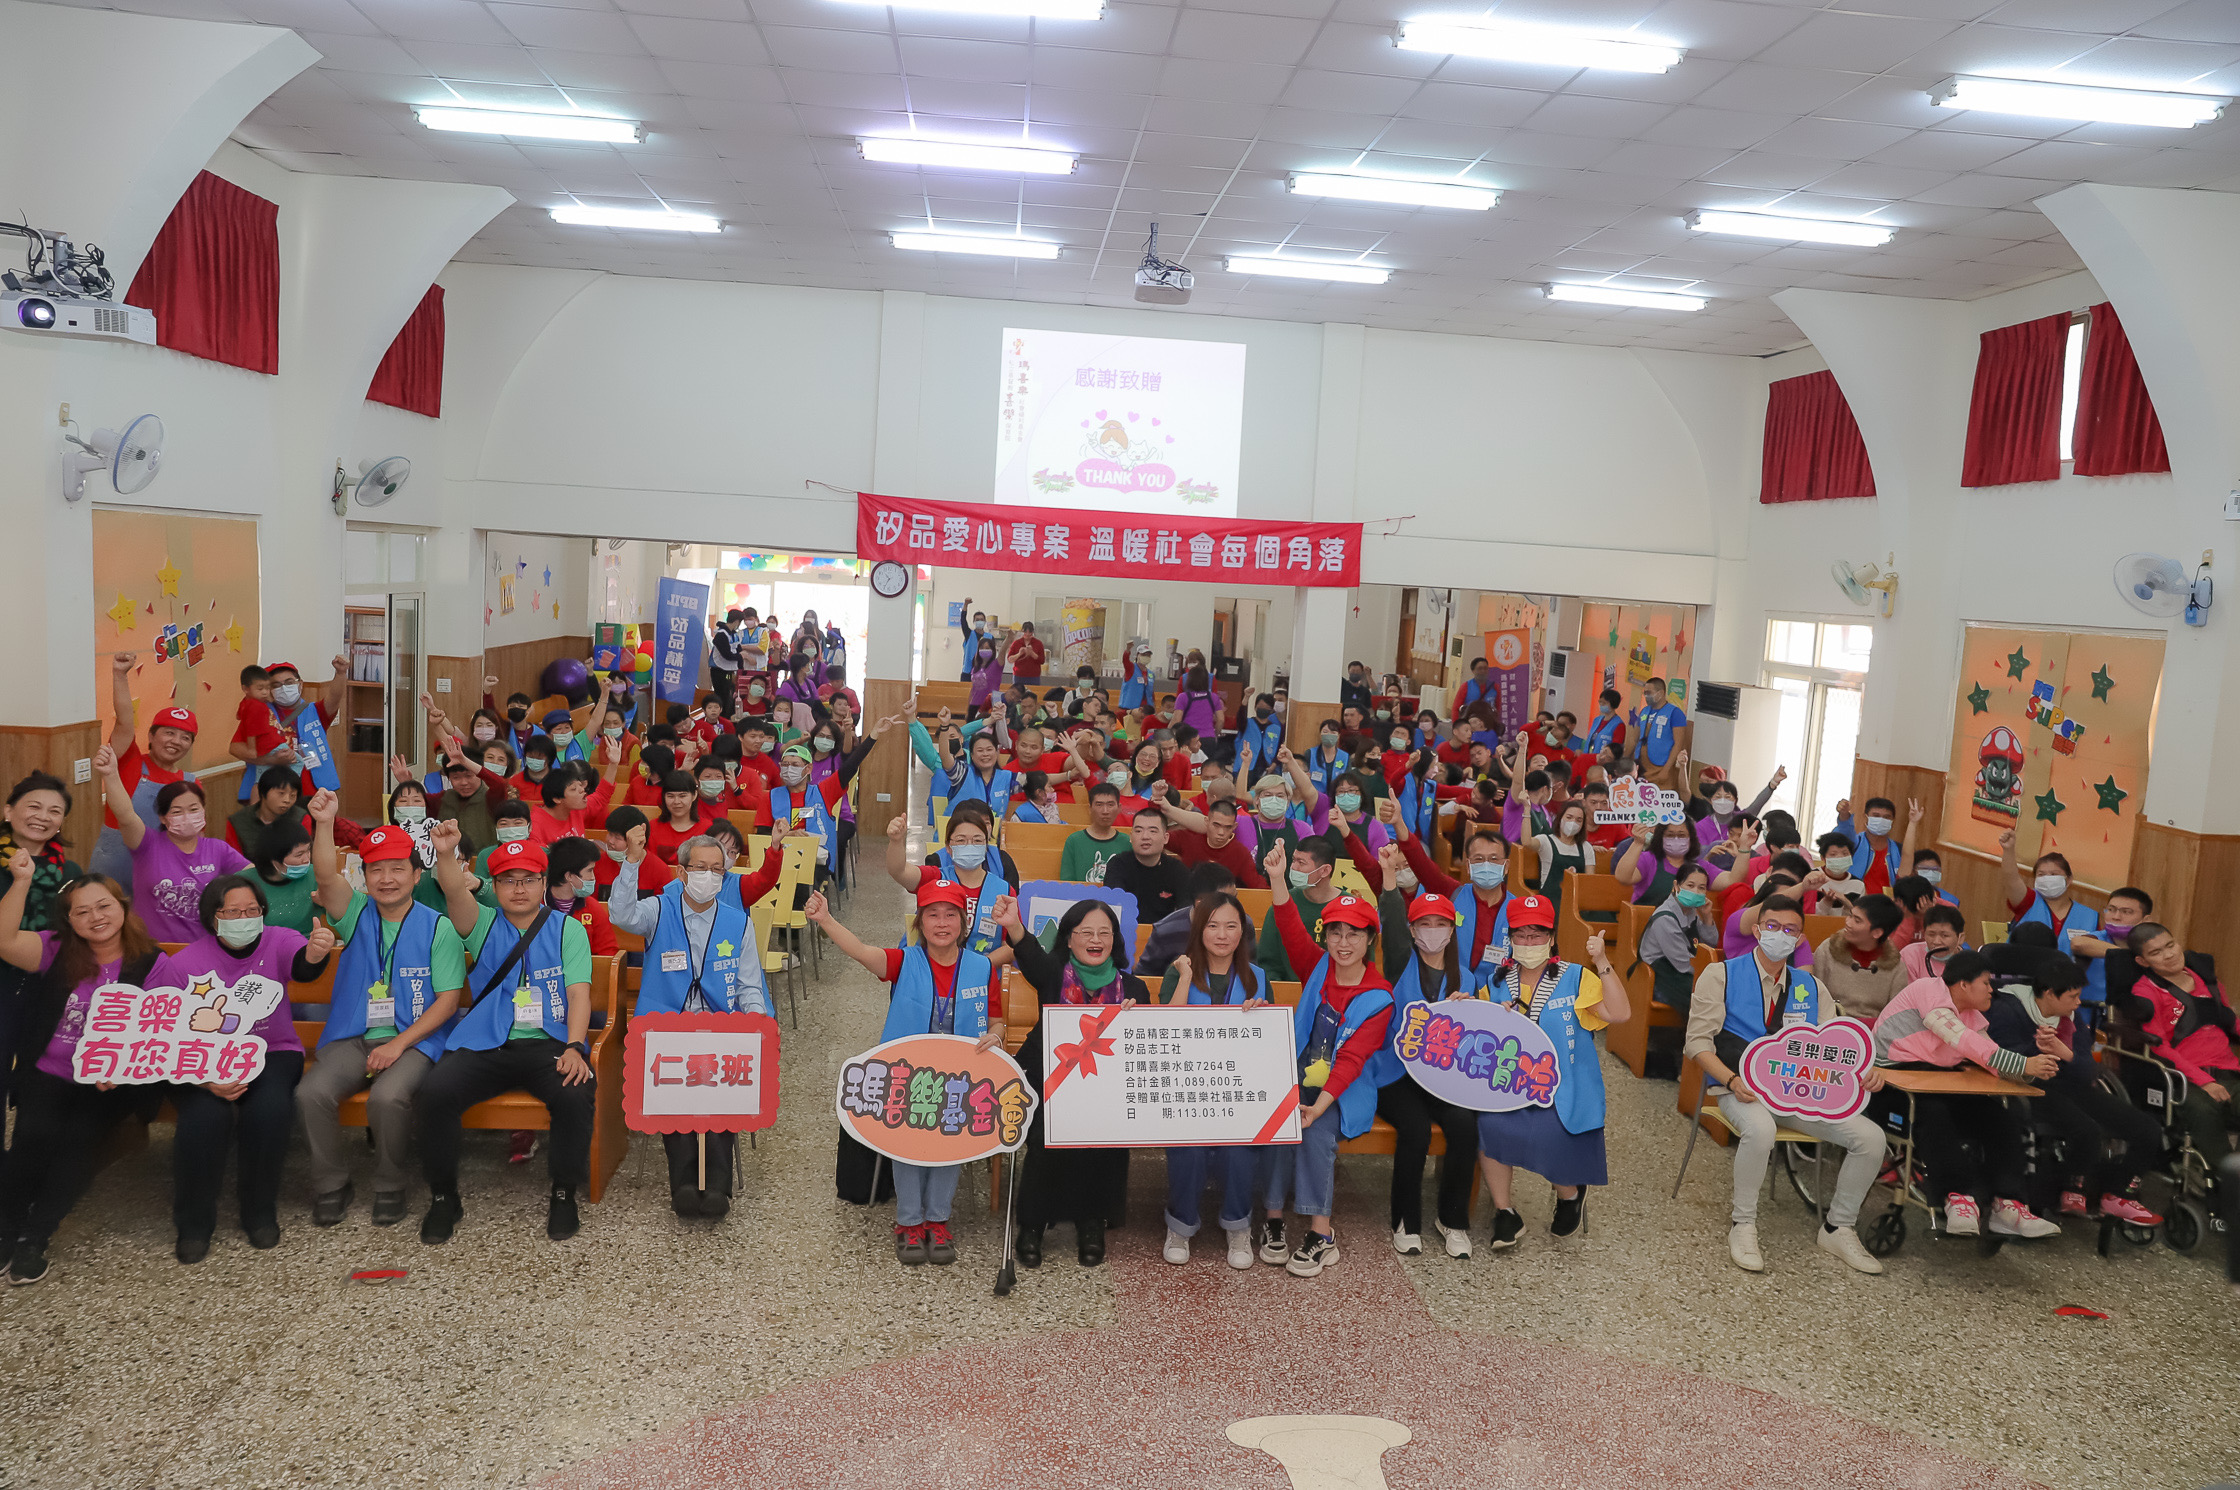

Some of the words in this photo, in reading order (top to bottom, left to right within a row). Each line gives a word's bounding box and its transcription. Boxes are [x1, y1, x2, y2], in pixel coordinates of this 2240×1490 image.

[1075, 367, 1162, 392] 感謝致贈
[1084, 468, 1133, 485] THANK
[1138, 472, 1166, 488] YOU
[875, 510, 1071, 561] 矽品愛心專案
[1088, 525, 1346, 573] 溫暖社會每個角落
[1596, 813, 1636, 821] THANKS
[92, 990, 182, 1034] 喜樂
[1124, 1027, 1263, 1040] 矽品精密工業股份有限公司
[79, 1036, 259, 1081] 有您真好
[1124, 1043, 1182, 1055] 矽品志工社
[1400, 1006, 1556, 1101] 喜樂保育院
[1786, 1039, 1857, 1065] 喜樂愛您
[650, 1053, 753, 1087] 仁愛班
[1124, 1060, 1236, 1073] 訂購喜樂水餃7264包
[1768, 1060, 1845, 1086] THANK
[1125, 1076, 1243, 1088] 合計金額1,089,600元
[1781, 1080, 1827, 1100] YOU
[846, 1062, 1029, 1143] 瑪喜樂基金會
[1125, 1090, 1267, 1104] 受贈單位:瑪喜樂社福基金會
[1127, 1109, 1136, 1119] 日
